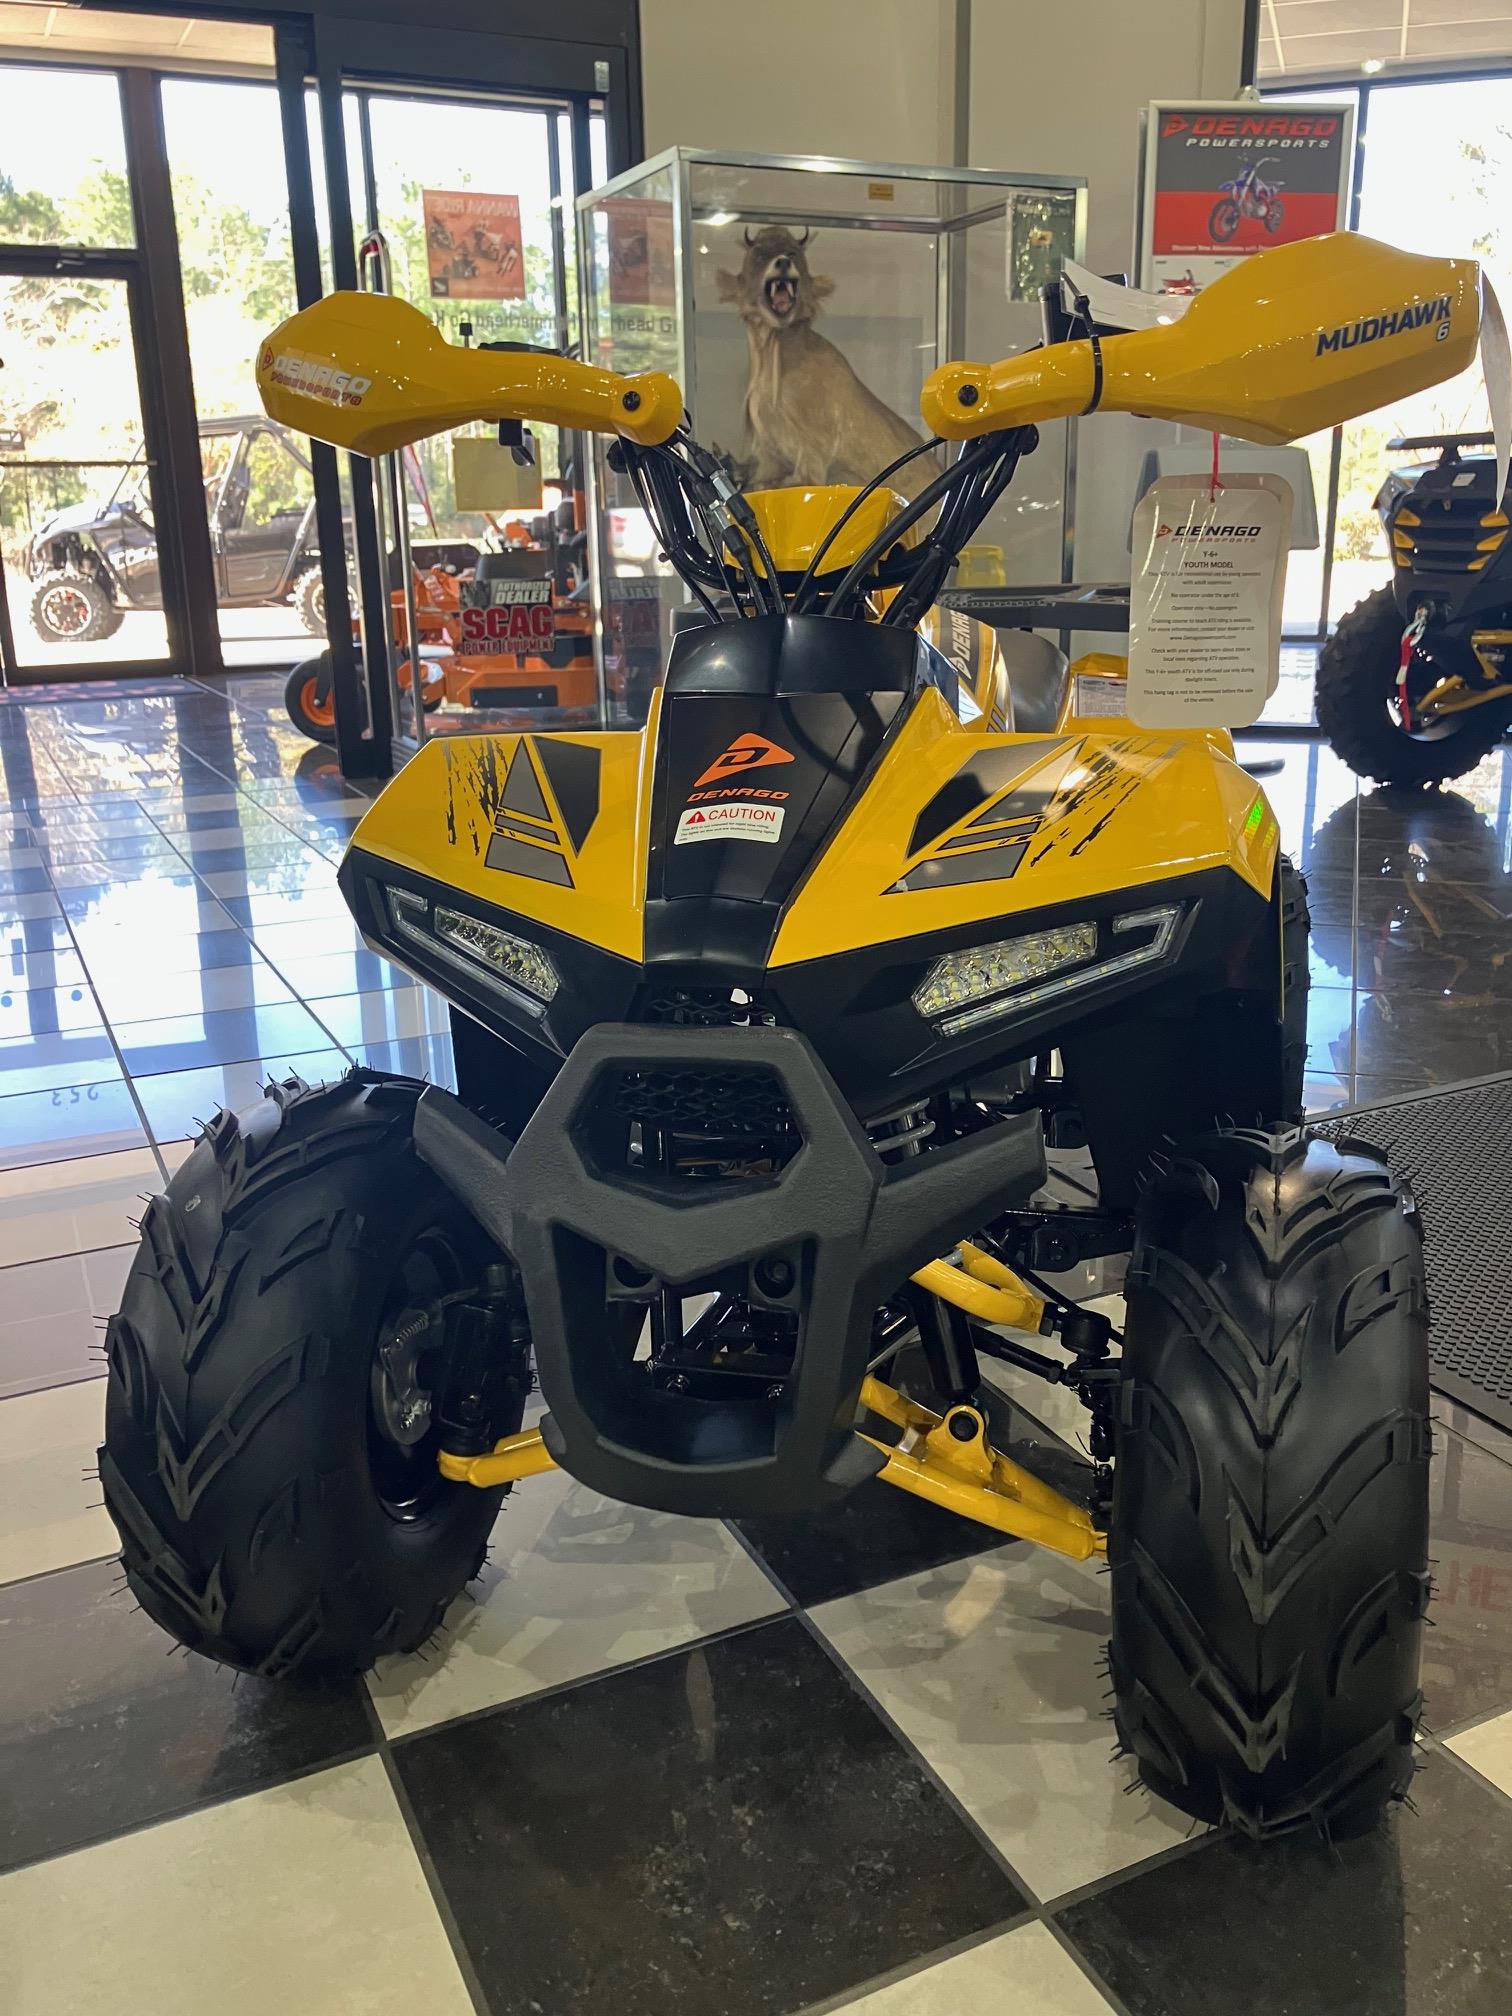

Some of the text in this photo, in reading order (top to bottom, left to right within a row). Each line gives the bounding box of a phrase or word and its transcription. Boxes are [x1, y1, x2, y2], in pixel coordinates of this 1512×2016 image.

[1192, 116, 1338, 137] DENAGO
[1186, 138, 1330, 148] POWERSPORTS
[1315, 296, 1452, 357] MUDHAWK
[1436, 321, 1451, 342] 6
[273, 354, 373, 396] DENAGO
[1174, 526, 1262, 537] DENAGO
[497, 580, 551, 591] AUTHORIZED
[495, 590, 550, 604] DEALER
[951, 609, 970, 662] DENAG
[464, 641, 499, 656] POWER
[686, 788, 790, 803] DENAGO
[708, 808, 776, 822] CAUTION
